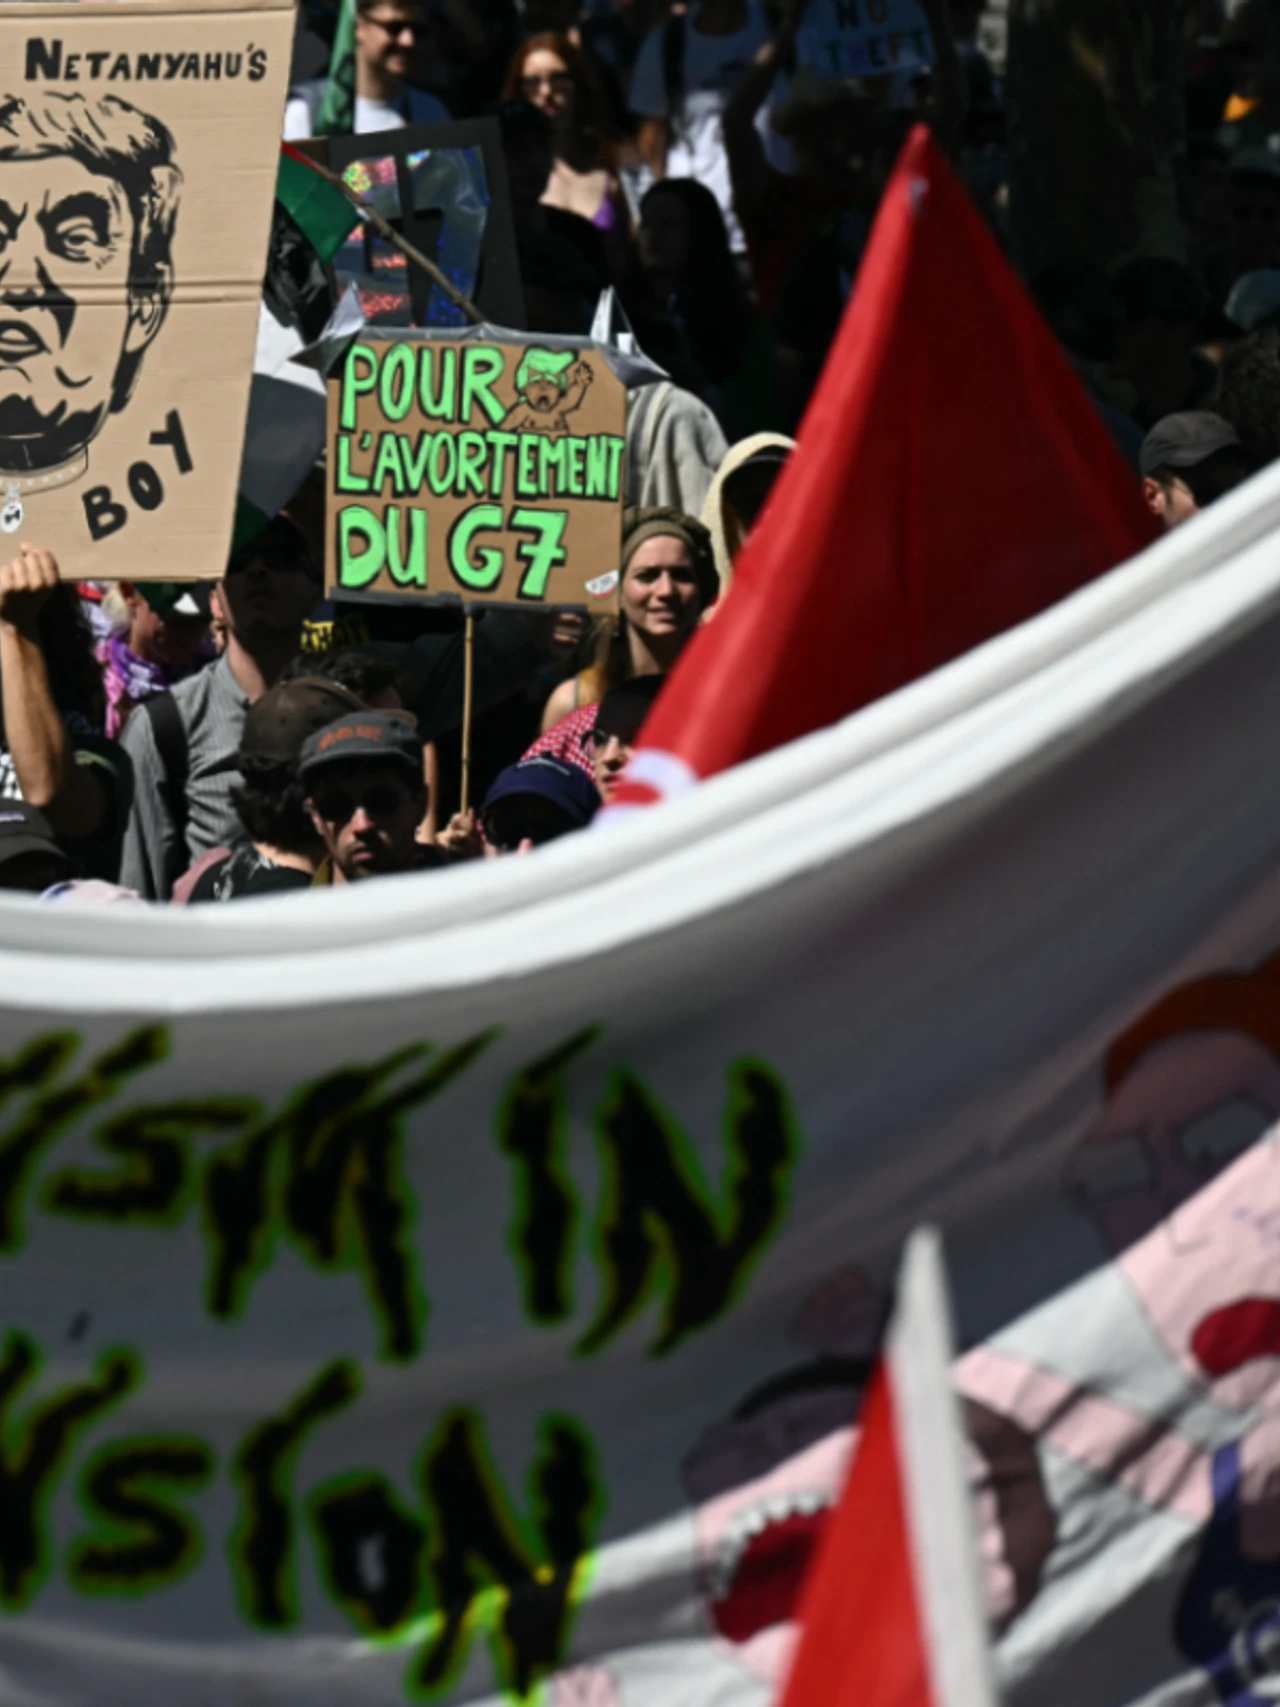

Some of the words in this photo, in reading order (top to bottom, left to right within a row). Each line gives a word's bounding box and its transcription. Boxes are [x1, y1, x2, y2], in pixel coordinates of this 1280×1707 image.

[340, 341, 509, 431] POUR
[81, 408, 194, 542] BOY
[335, 429, 625, 500] L'AVORTEMENT
[337, 503, 429, 590] DU
[447, 502, 569, 601] G7
